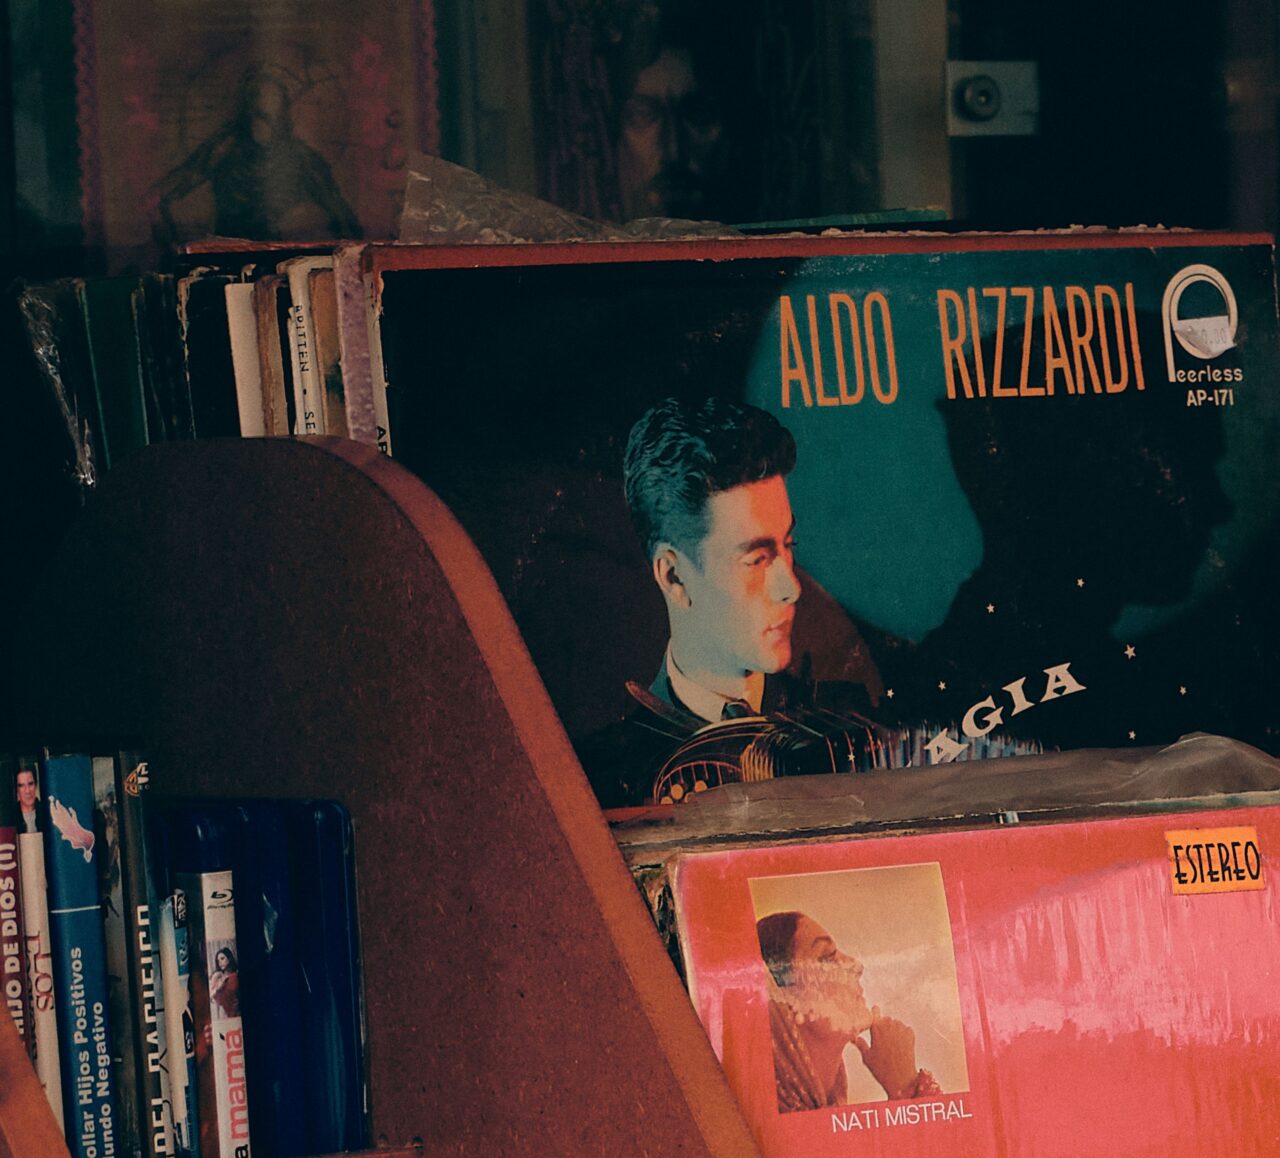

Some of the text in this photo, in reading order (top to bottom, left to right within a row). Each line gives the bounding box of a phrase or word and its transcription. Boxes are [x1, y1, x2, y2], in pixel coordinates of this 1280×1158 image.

[780, 282, 1145, 408] ALDO RIZZARDI
[304, 411, 316, 436] SE
[1186, 388, 1235, 407] AP-171
[920, 661, 1088, 768] AGIA
[1173, 840, 1261, 886] ESTEREO
[0, 876, 18, 937] DIOS
[3, 943, 21, 974] DE
[70, 946, 90, 1045] Positivos
[77, 1049, 96, 1106] Hijos
[91, 1001, 112, 1098] Negativo
[831, 1098, 973, 1133] NATI MISTRAL
